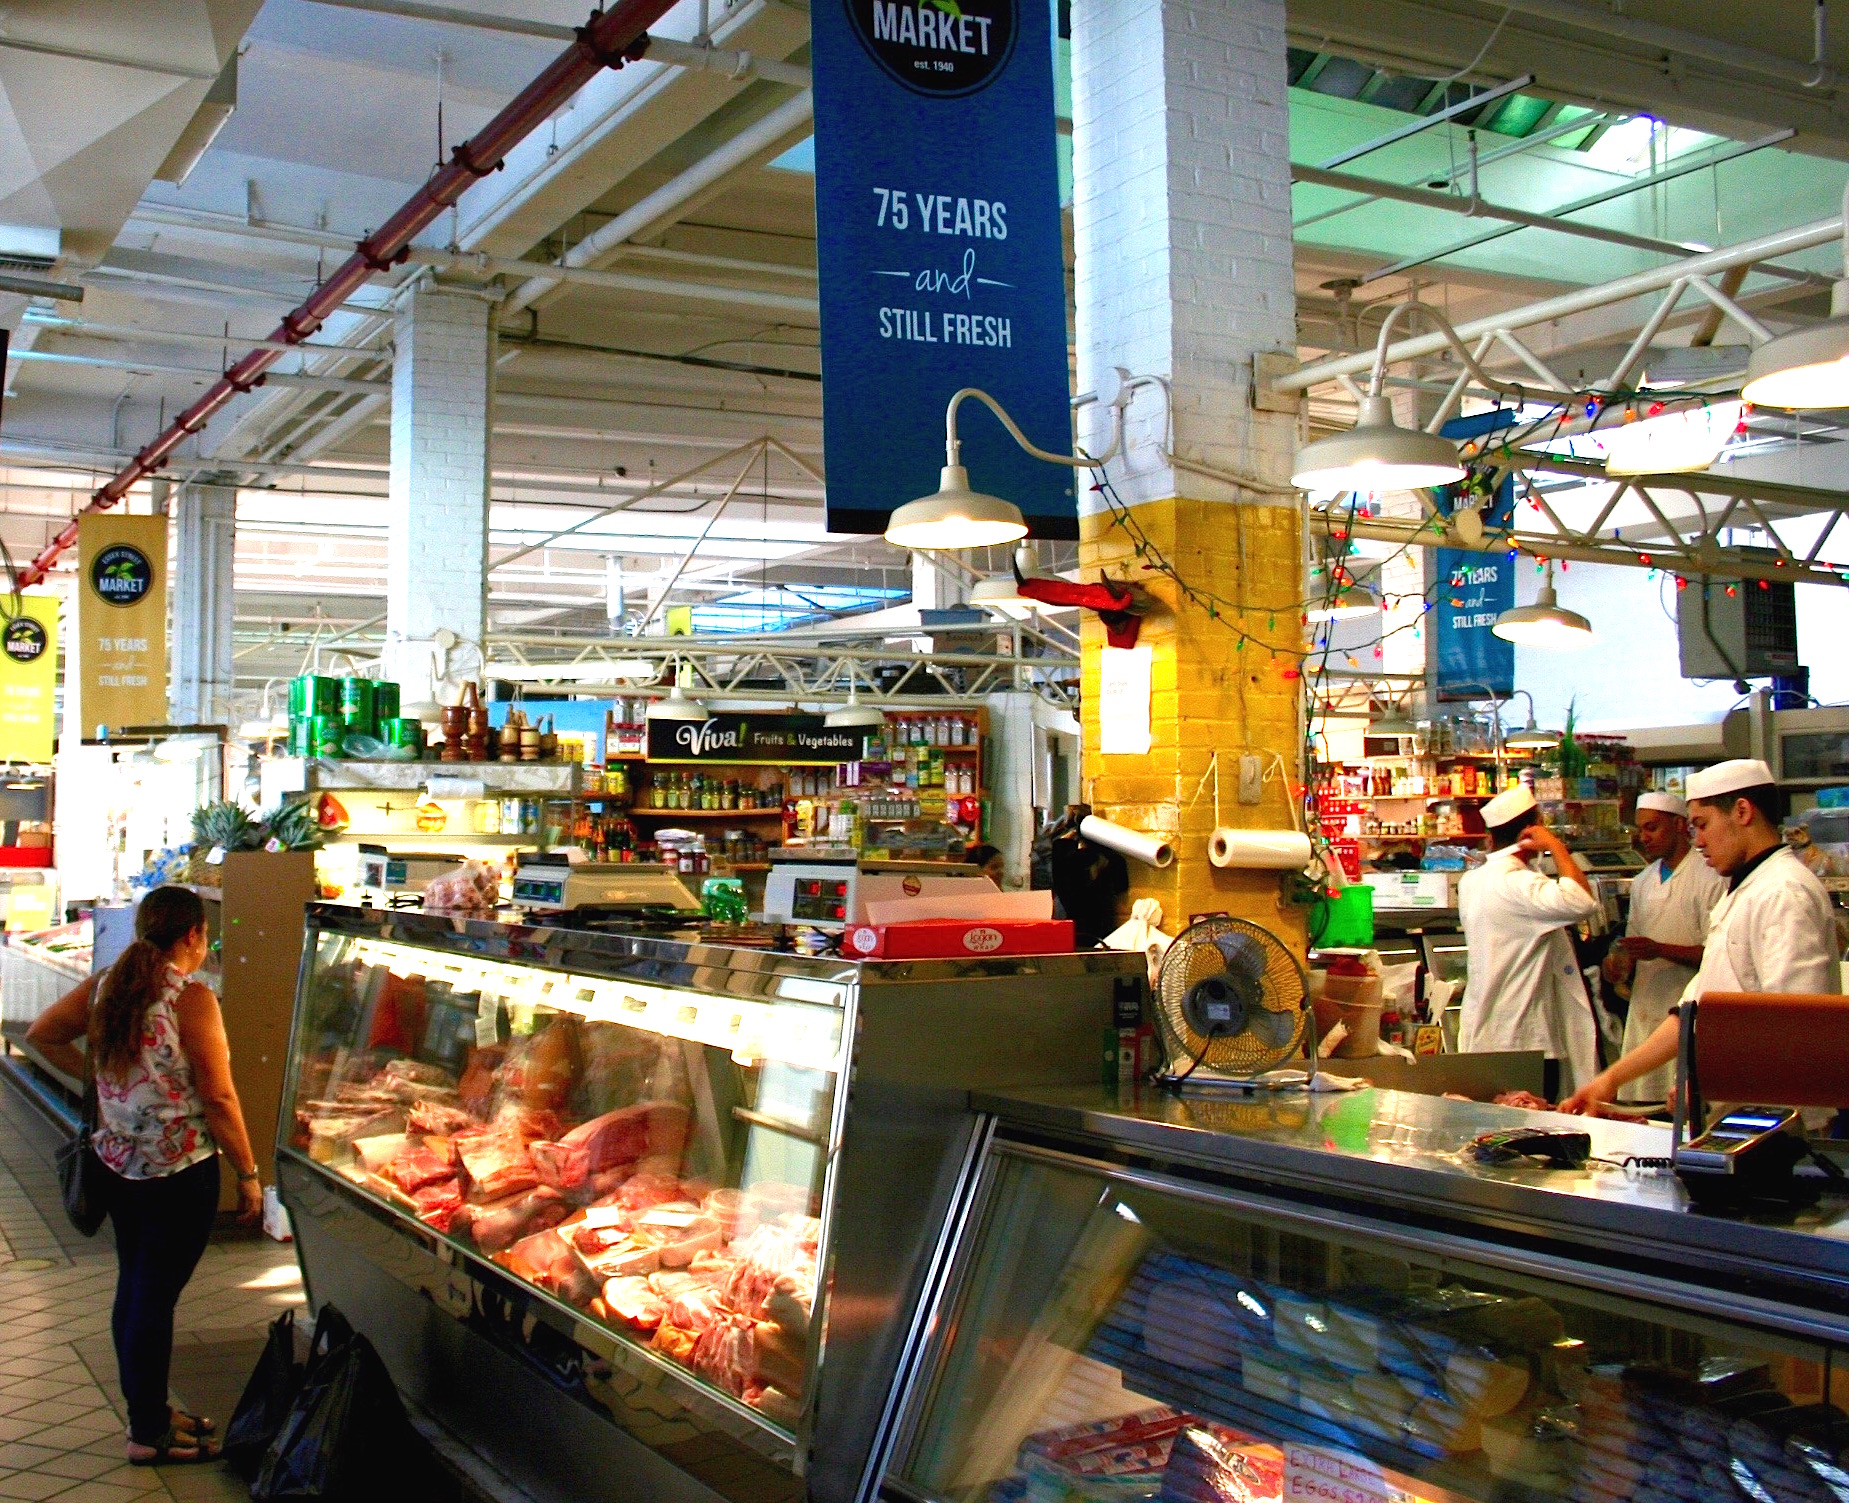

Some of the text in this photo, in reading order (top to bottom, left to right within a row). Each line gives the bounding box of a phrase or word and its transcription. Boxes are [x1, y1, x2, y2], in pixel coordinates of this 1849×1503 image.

[873, 0, 992, 55] MARKET
[914, 60, 954, 73] est. 1940
[873, 187, 1008, 240] 75 YEARS
[915, 248, 975, 300] and
[879, 306, 1012, 348] STILL FRESH
[99, 578, 143, 592] MARKET
[1452, 613, 1498, 629] STILL FRESH
[7, 641, 41, 654] MARKET
[113, 638, 148, 652] YEARS
[676, 717, 747, 756] Viva!
[754, 732, 783, 745] Fruits
[787, 733, 796, 746] &
[798, 733, 853, 749] Vegetables
[1292, 1475, 1337, 1500] EGGS
